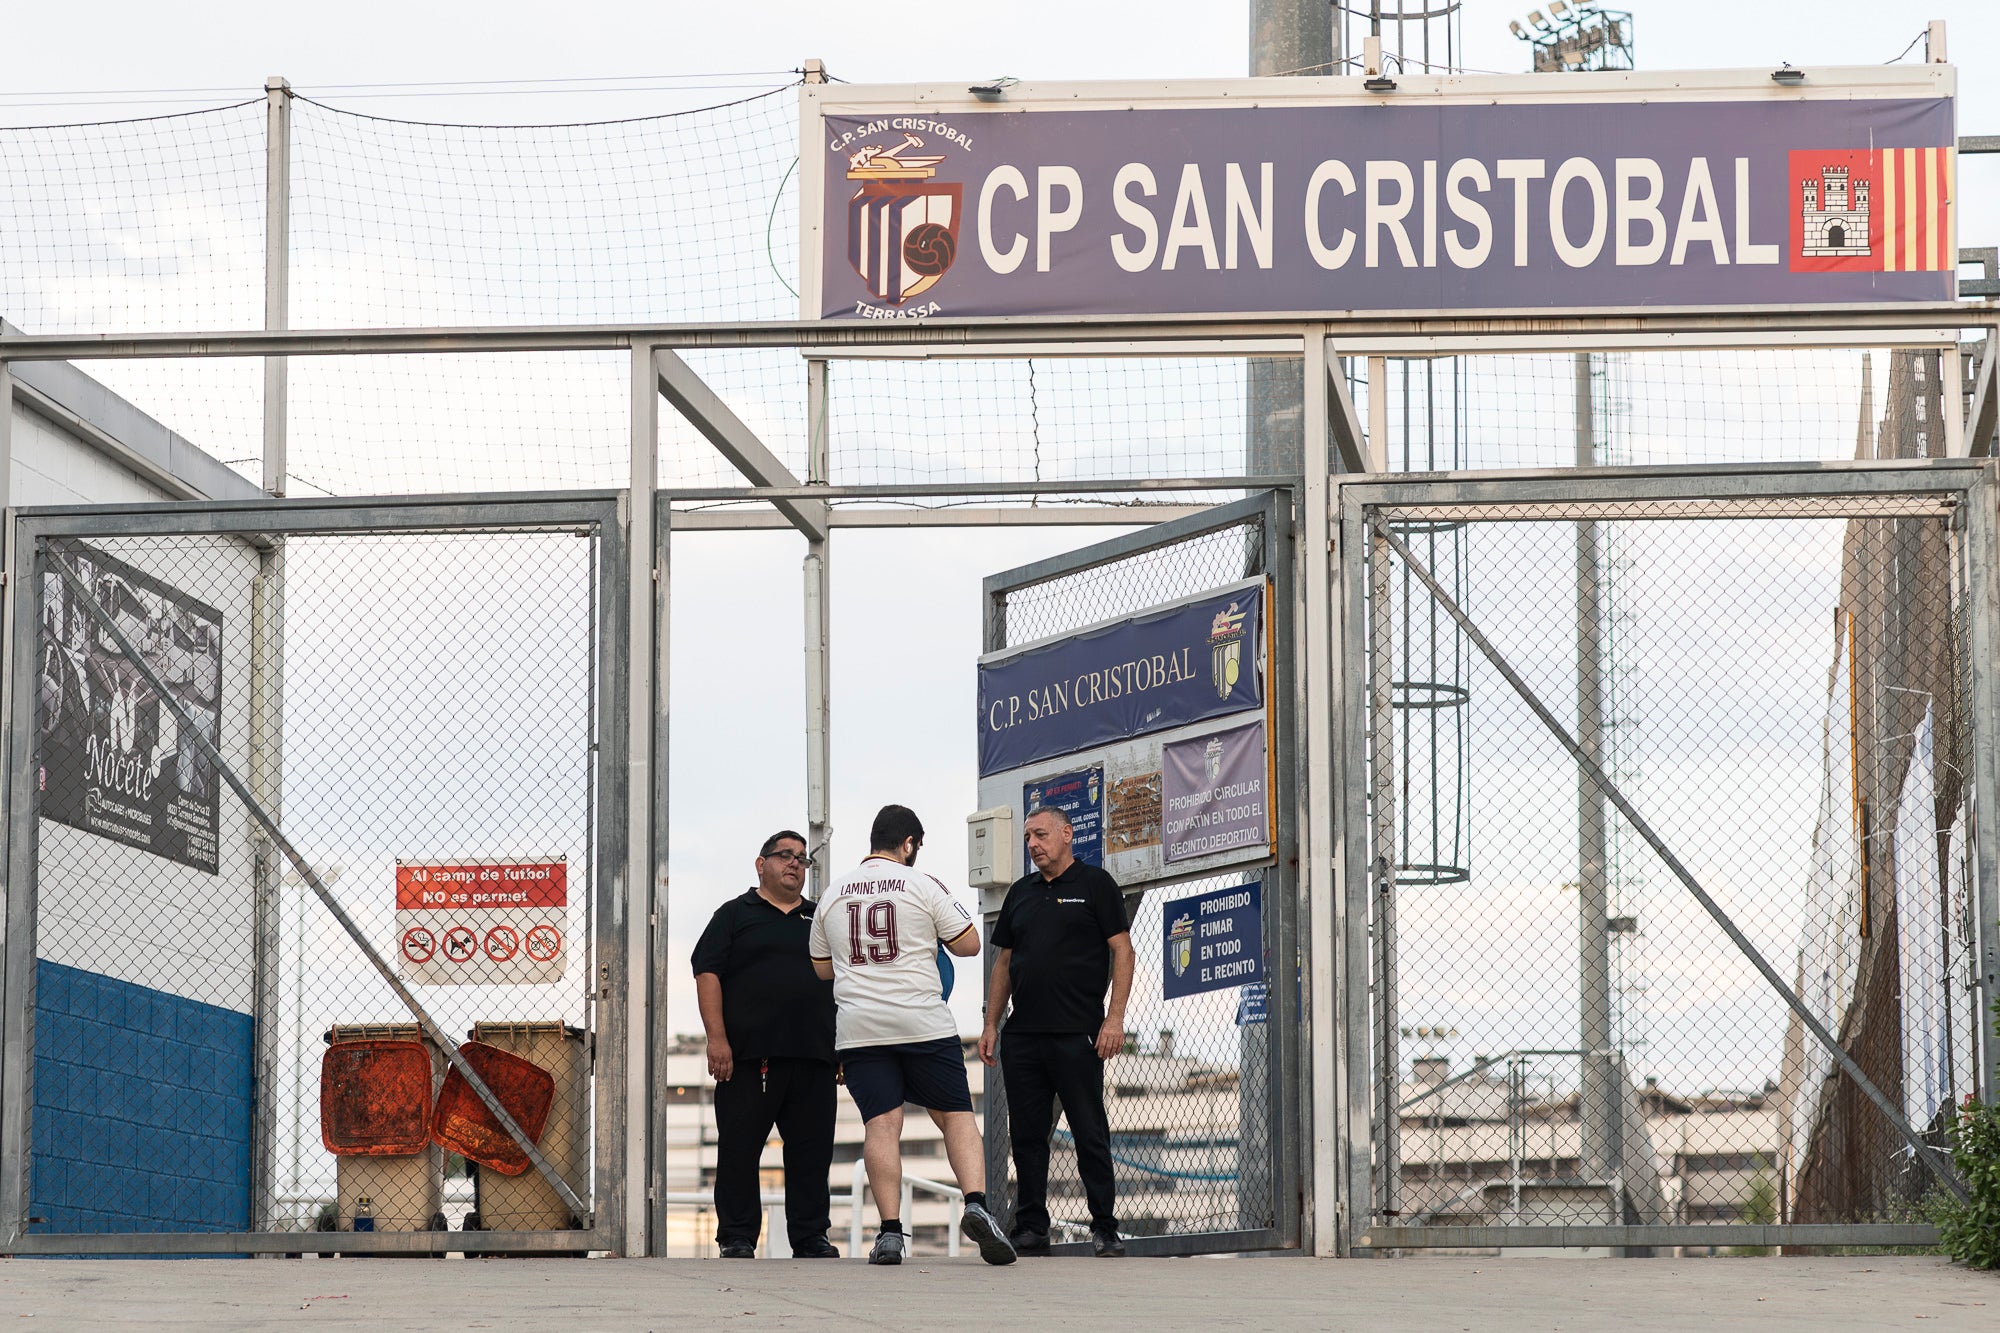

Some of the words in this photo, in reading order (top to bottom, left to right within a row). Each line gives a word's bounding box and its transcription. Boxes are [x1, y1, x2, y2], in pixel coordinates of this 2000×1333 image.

[830, 131, 857, 152] C.P.
[857, 118, 890, 138] SAN
[892, 117, 974, 152] CRISTÓBAL
[978, 164, 1084, 274] CP
[1110, 161, 1274, 273] SAN
[1305, 157, 1780, 271] CRISTOBAL
[855, 299, 942, 320] TERRASSA
[989, 694, 1024, 732] C.P.
[1027, 679, 1069, 721] SAN
[1074, 646, 1197, 708] CRISTOBAL
[84, 733, 152, 802] Nocete
[1169, 790, 1212, 811] PROHIBIDO
[1214, 779, 1260, 800] CIRCULAR
[1166, 819, 1185, 834] CON
[1212, 810, 1224, 825] EN
[1225, 805, 1250, 821] TODO
[1251, 802, 1262, 816] EL
[1170, 837, 1208, 856] RECINTO
[1209, 826, 1258, 848] DEPORTIVO
[411, 869, 427, 882] Al
[432, 870, 476, 884] camp
[480, 868, 500, 881] de
[503, 867, 551, 881] futbol
[840, 881, 875, 896] LAMINE
[876, 879, 906, 894] YAMAL
[422, 891, 446, 904] NO
[450, 892, 468, 903] es
[472, 889, 529, 905] permet
[1200, 891, 1251, 915] PROHIBIDO
[846, 899, 900, 967] 19
[1200, 917, 1233, 938] FUMAR
[1200, 944, 1213, 960] EN
[1215, 938, 1241, 957] TODO
[1201, 967, 1213, 982] EL
[1214, 958, 1255, 980] RECINTO
